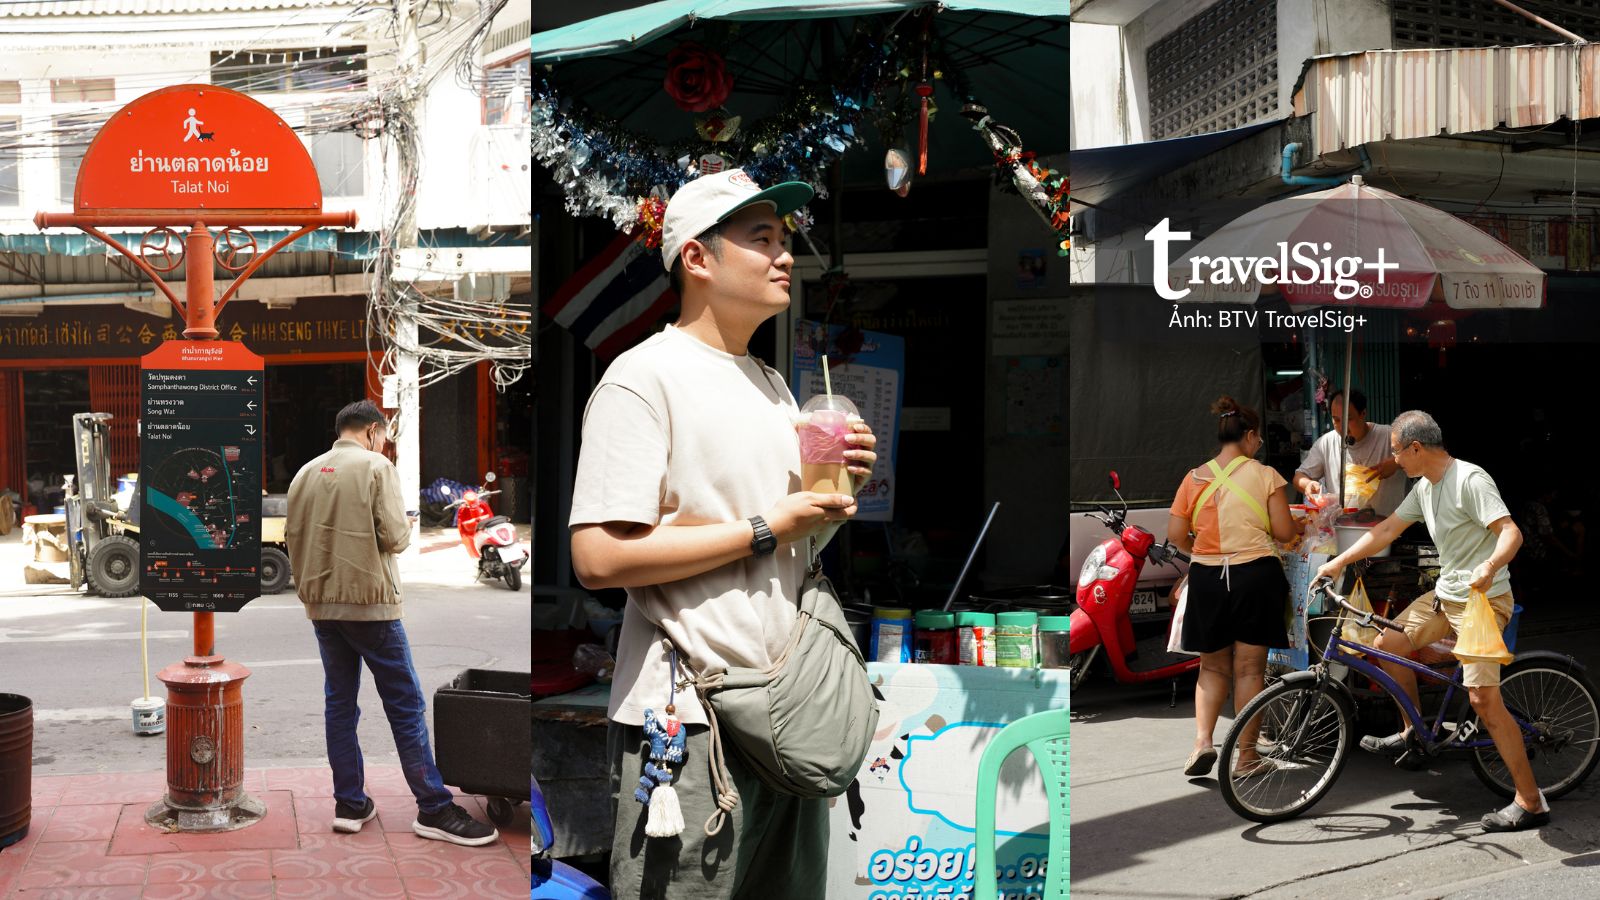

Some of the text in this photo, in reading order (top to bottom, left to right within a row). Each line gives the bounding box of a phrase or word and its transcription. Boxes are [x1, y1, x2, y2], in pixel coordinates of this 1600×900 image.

[130, 148, 269, 173] ย่านตลาดน้อย
[170, 180, 229, 193] Talat Noi
[1453, 277, 1537, 299] 7 ถึง 11 โมงเช้า
[252, 322, 276, 341] HAH
[280, 321, 312, 341] SENG
[315, 320, 347, 340] THYE
[147, 408, 162, 416] Song
[147, 421, 191, 430] ย่านตลาดน้อย
[81, 432, 90, 468] TCM
[1131, 592, 1153, 605] 624
[871, 839, 975, 882] อร่อย!
